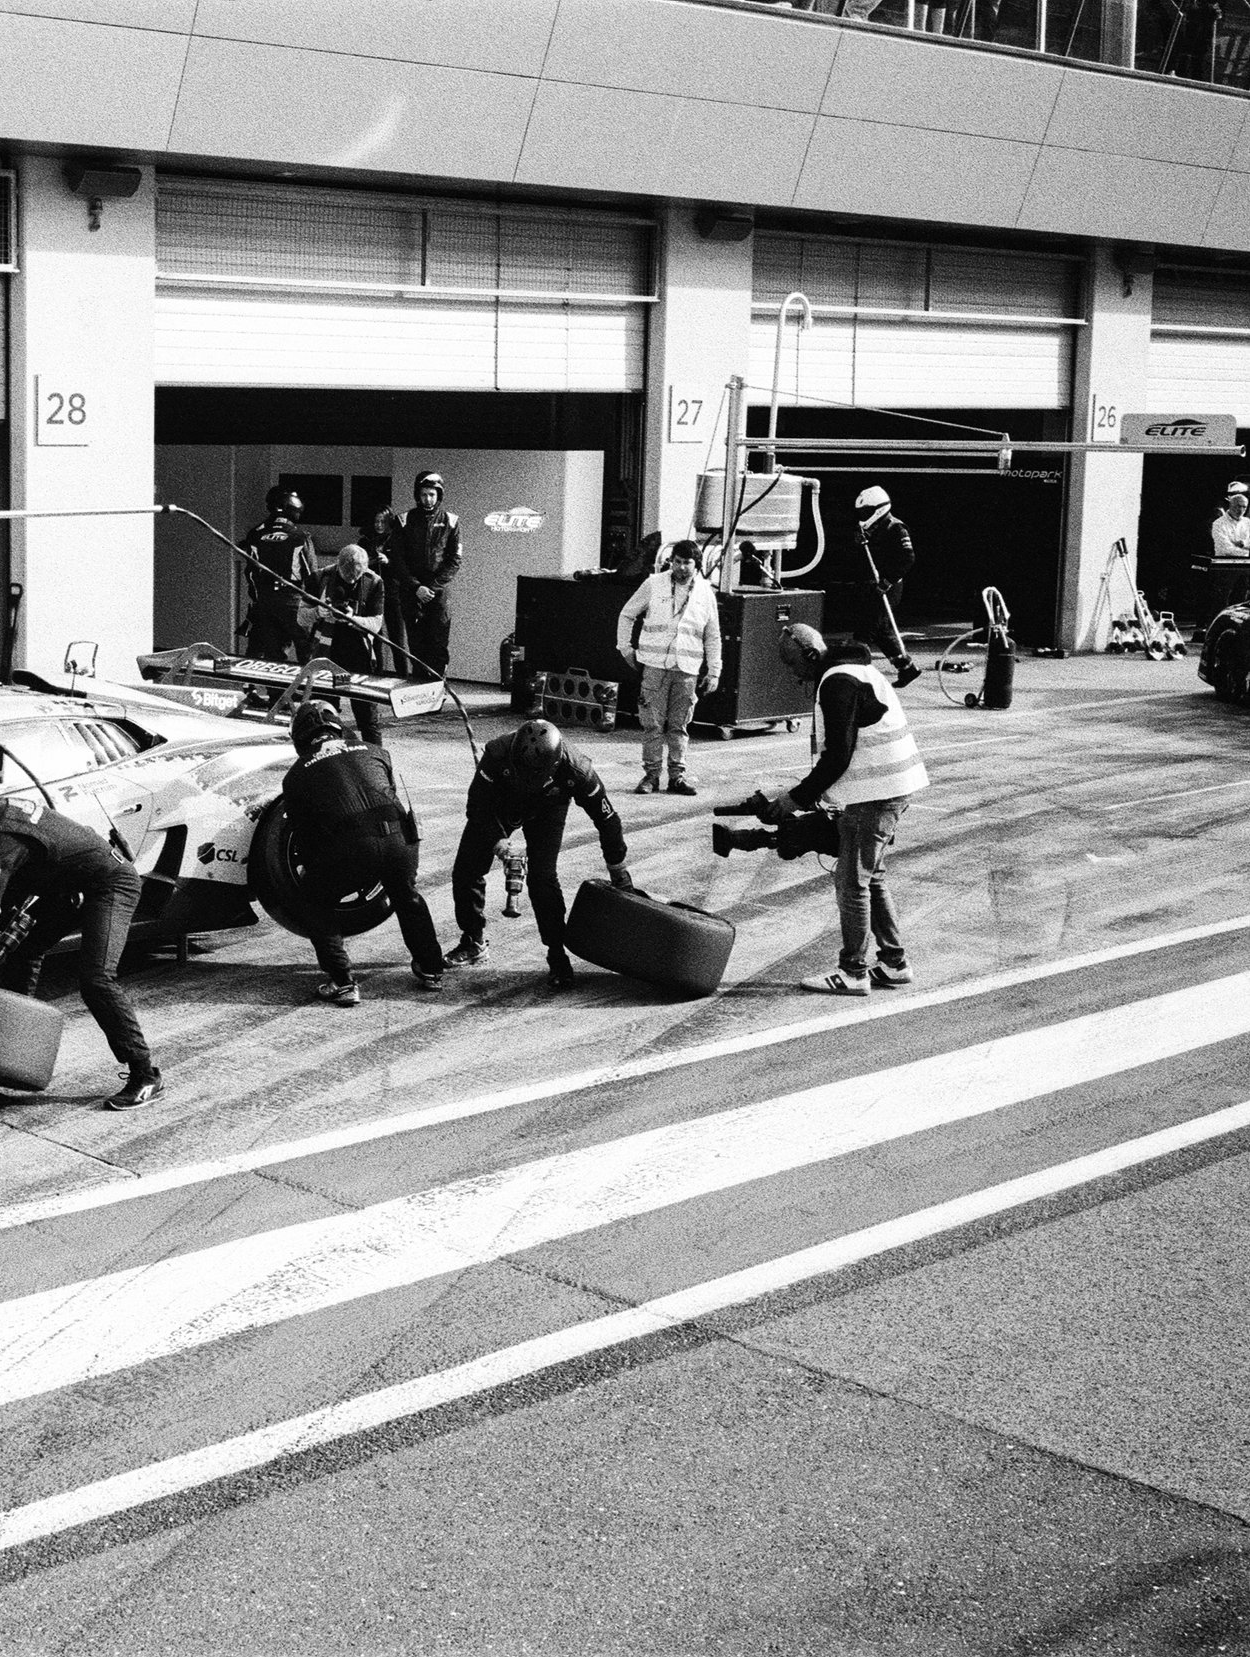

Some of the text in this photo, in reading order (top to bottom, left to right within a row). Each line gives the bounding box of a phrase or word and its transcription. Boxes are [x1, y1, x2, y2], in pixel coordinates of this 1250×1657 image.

[46, 392, 87, 425] 28
[676, 399, 703, 425] 27
[1097, 405, 1116, 428] 26
[1144, 426, 1207, 437] ELITE
[484, 514, 542, 528] ELITE
[203, 691, 239, 711] Bitget
[304, 749, 342, 767] OREGON
[216, 849, 239, 862] CSL
